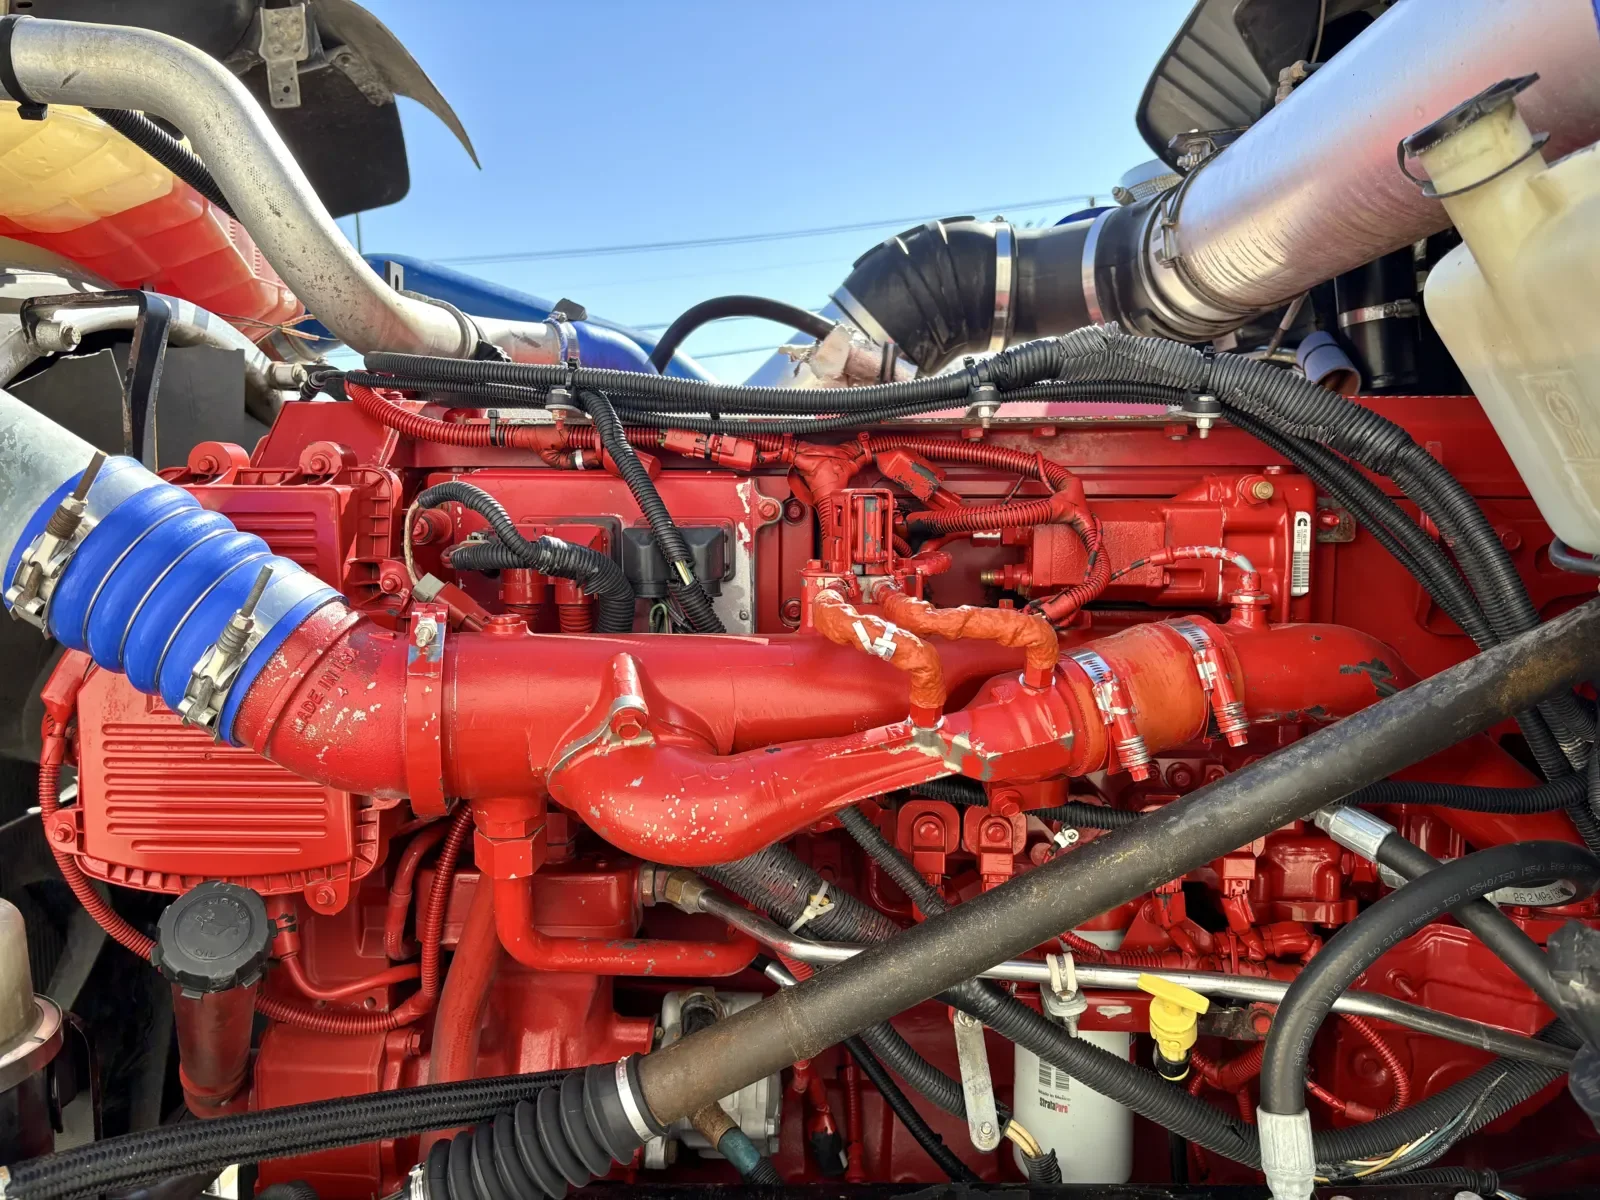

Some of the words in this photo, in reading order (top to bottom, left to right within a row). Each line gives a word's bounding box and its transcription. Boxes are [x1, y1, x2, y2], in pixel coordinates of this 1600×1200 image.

[288, 689, 326, 735] MADE
[317, 668, 340, 692] IN
[203, 896, 248, 920] ENGINE
[1513, 891, 1536, 903] 26.2
[1536, 890, 1554, 902] MPa
[1367, 946, 1382, 957] to
[1382, 924, 1406, 947] 212F
[1409, 906, 1439, 927] Meets
[1442, 893, 1461, 908] ISO
[194, 945, 218, 958] OIL
